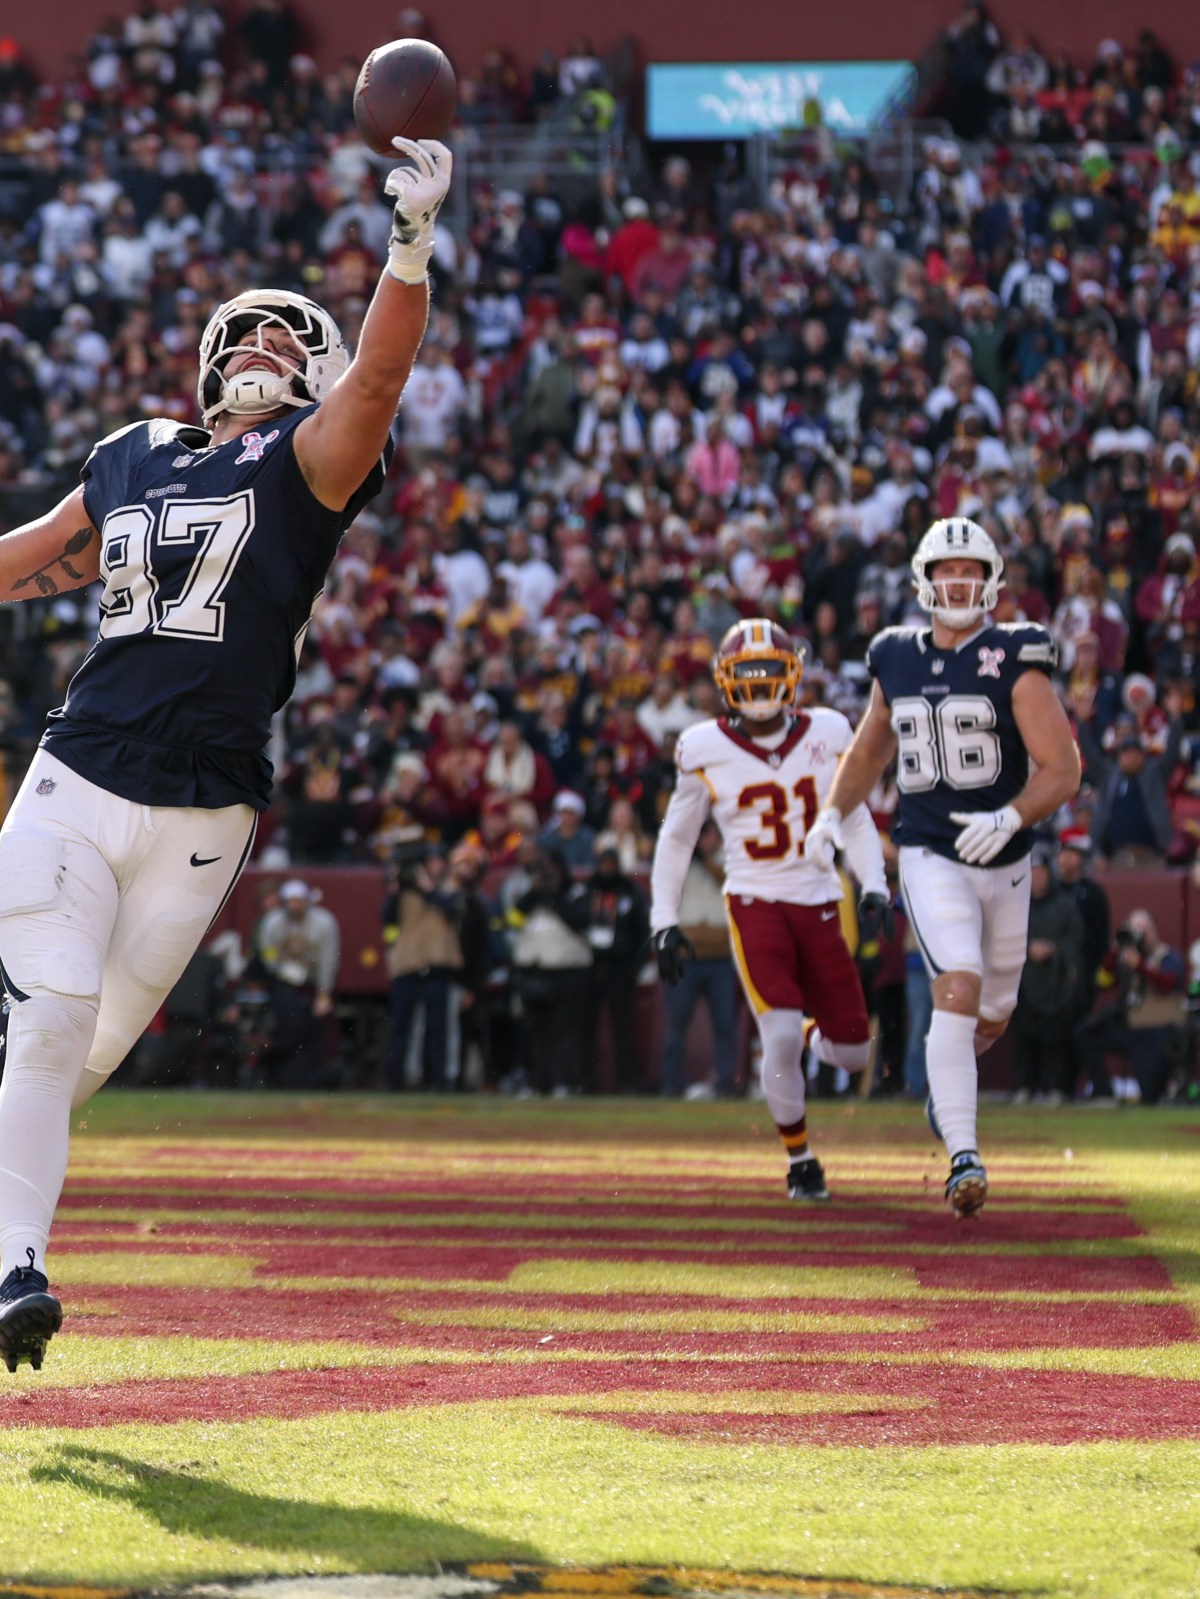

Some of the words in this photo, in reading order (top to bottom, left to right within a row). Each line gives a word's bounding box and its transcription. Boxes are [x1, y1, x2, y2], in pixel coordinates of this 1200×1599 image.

[99, 488, 255, 643] 87
[891, 694, 1002, 794] 86
[737, 774, 819, 862] 31
